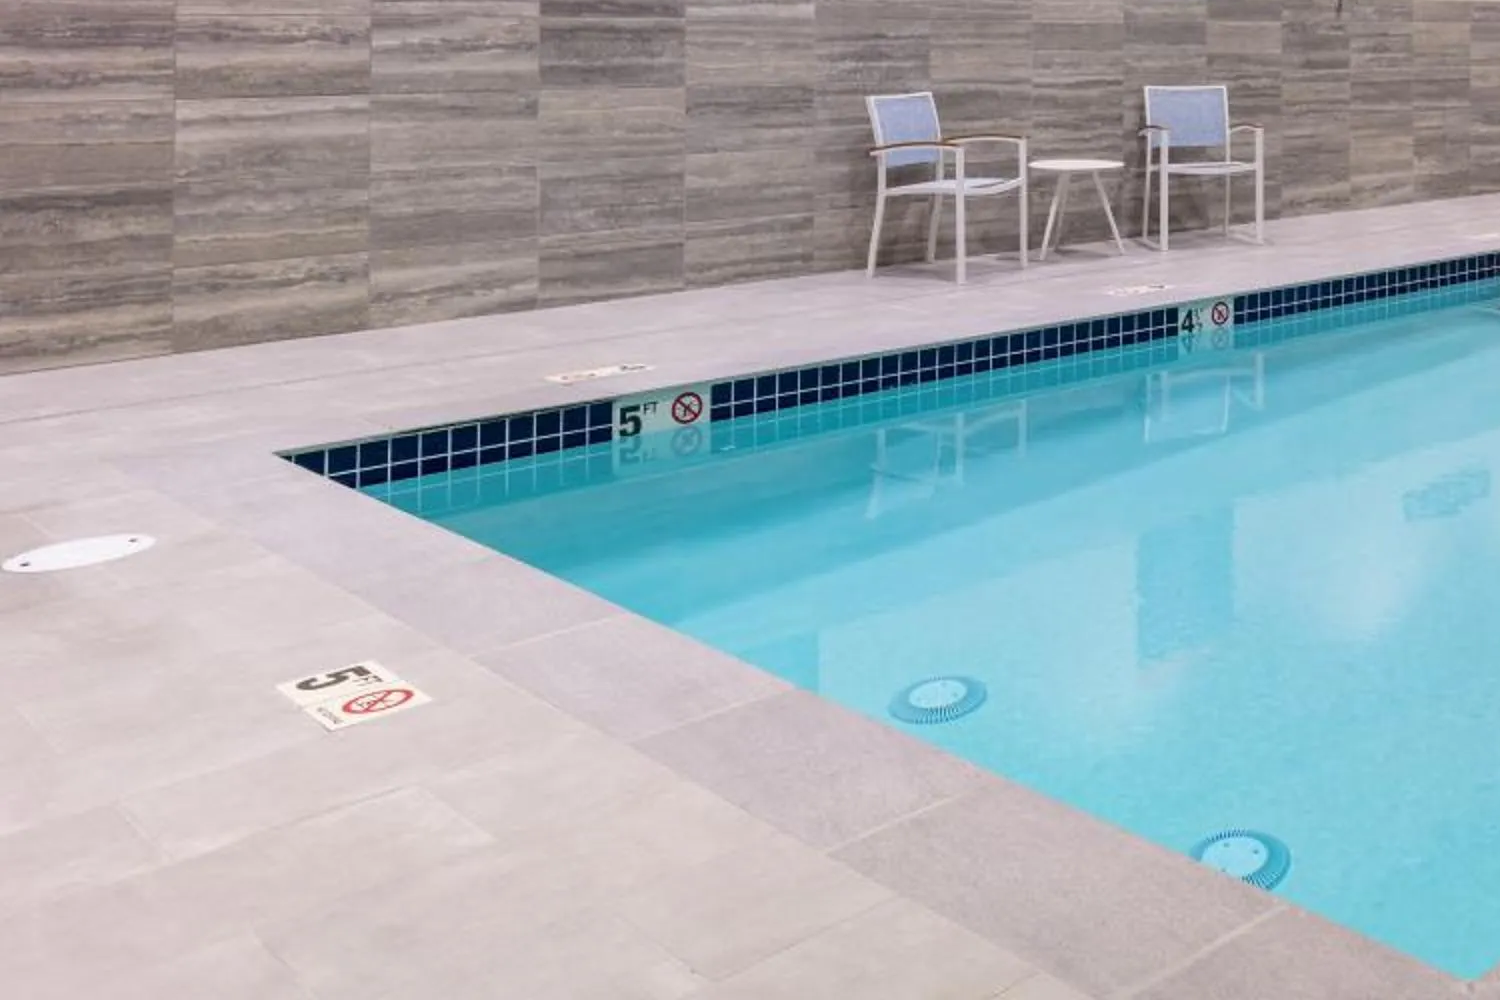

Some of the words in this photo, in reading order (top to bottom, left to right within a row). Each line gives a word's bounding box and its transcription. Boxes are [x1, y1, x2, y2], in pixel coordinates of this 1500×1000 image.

[1181, 308, 1196, 333] 4
[619, 403, 643, 437] 5
[643, 400, 661, 415] FT
[296, 665, 372, 691] 5
